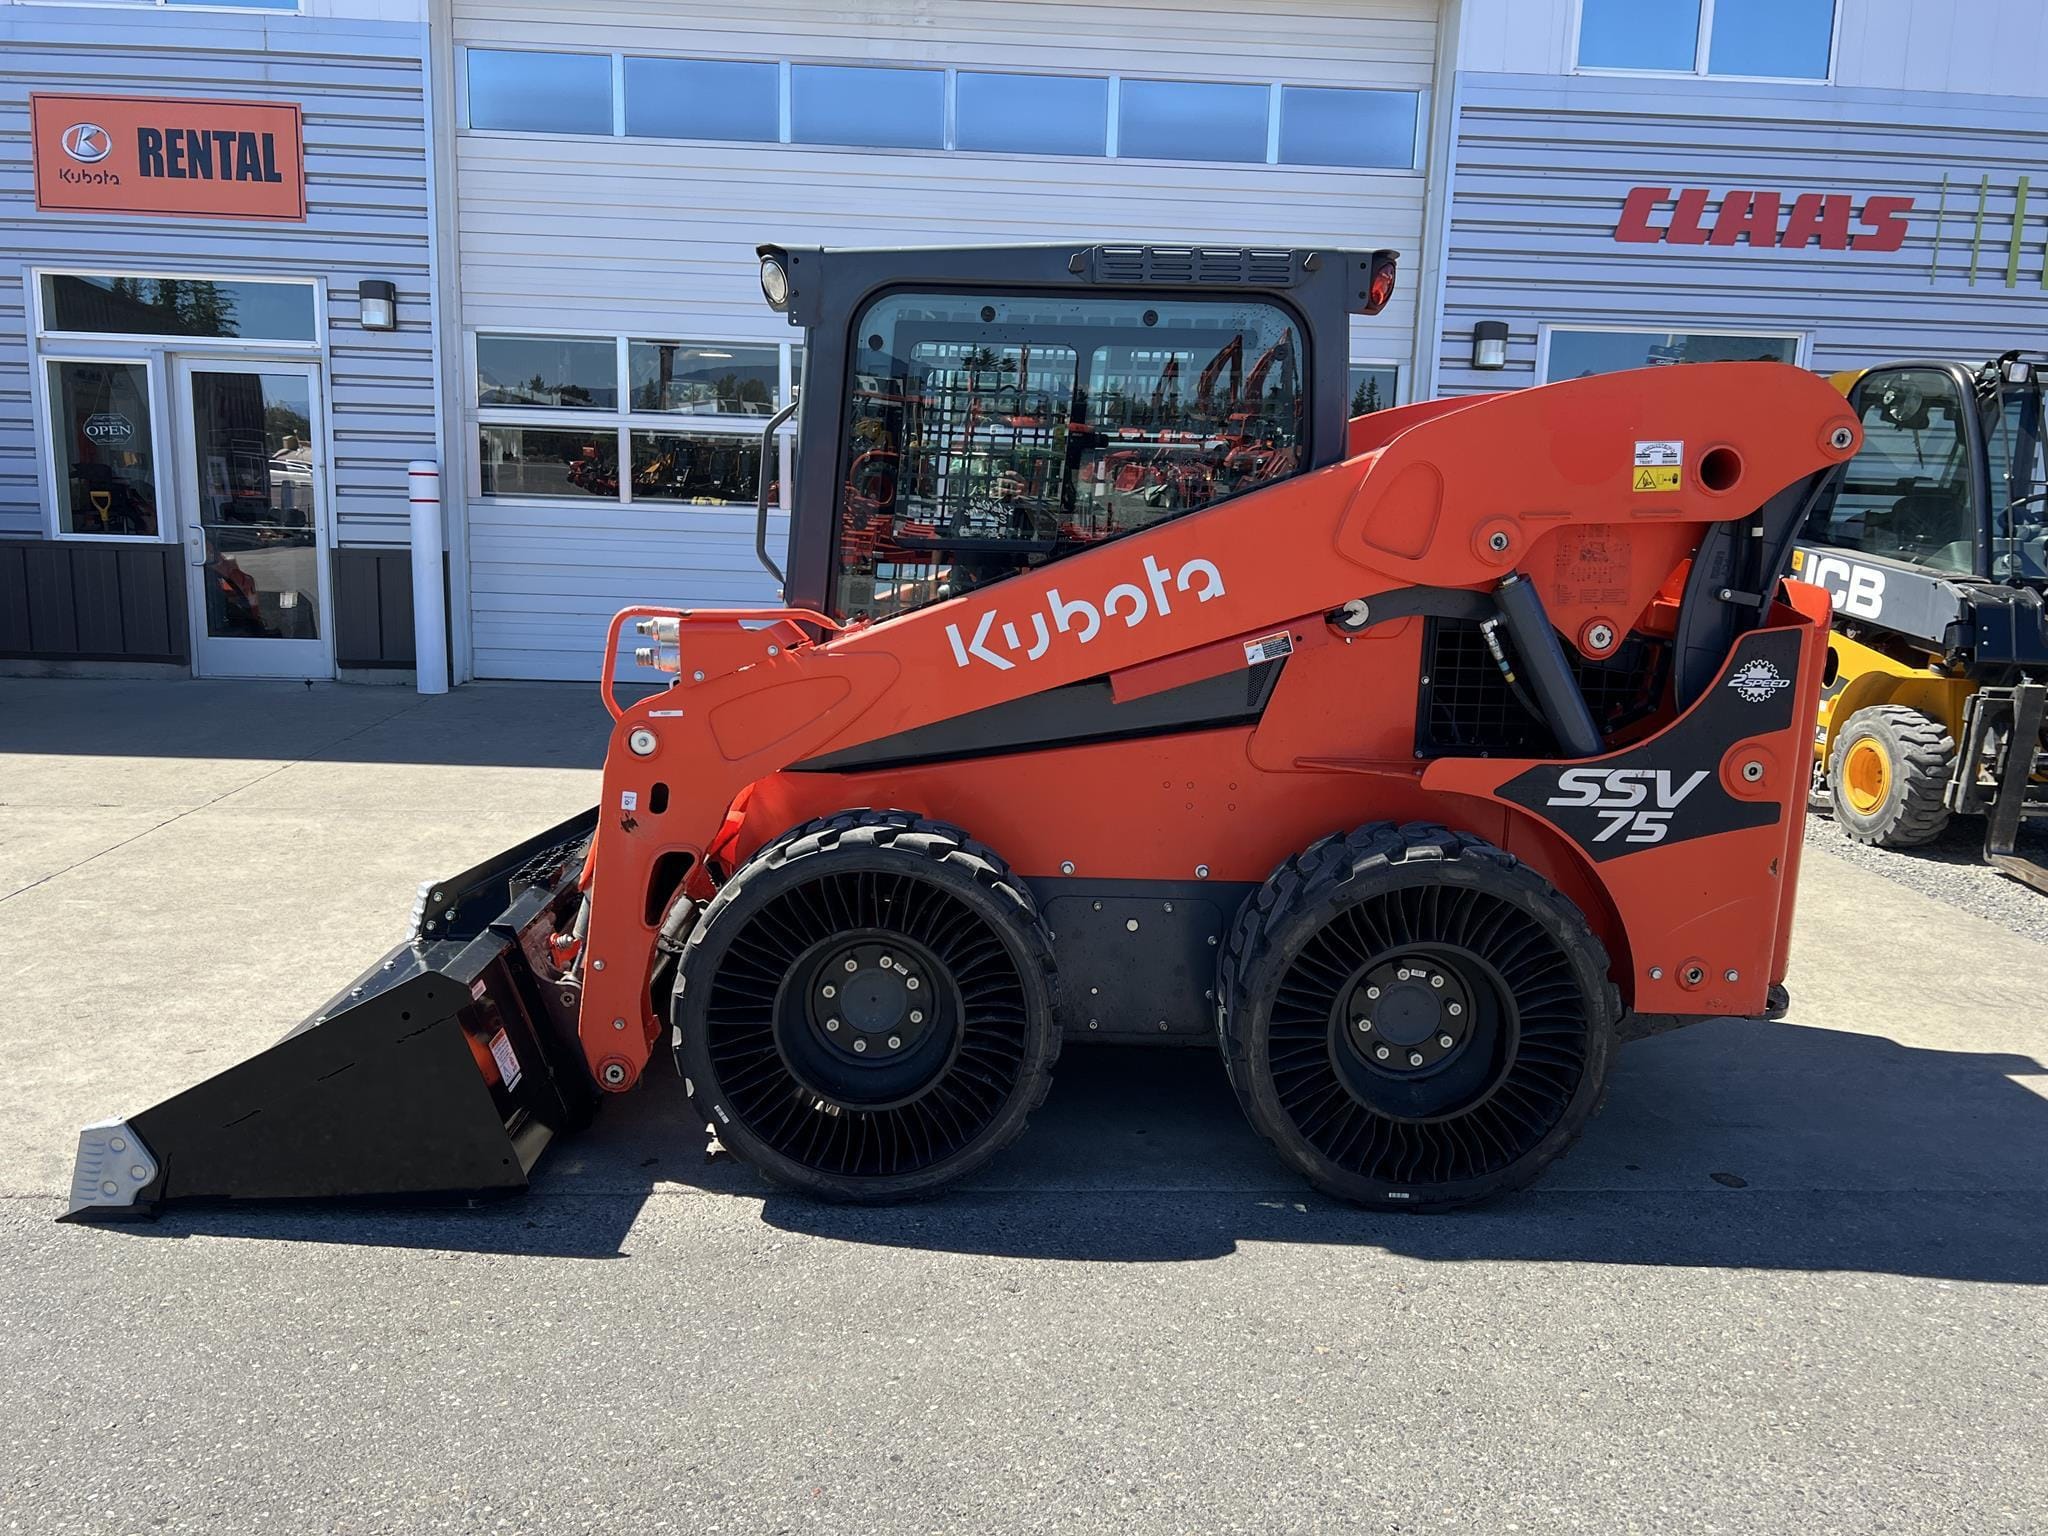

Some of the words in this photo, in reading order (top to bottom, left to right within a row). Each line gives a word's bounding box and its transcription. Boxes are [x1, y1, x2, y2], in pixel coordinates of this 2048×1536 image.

[137, 127, 282, 183] RENTAL
[59, 168, 121, 186] Kubota
[1614, 187, 1916, 252] CLAAS
[86, 425, 131, 436] OPEN
[945, 555, 1226, 671] Kubota
[1546, 768, 1711, 809] SSV
[1591, 810, 1674, 843] 75
